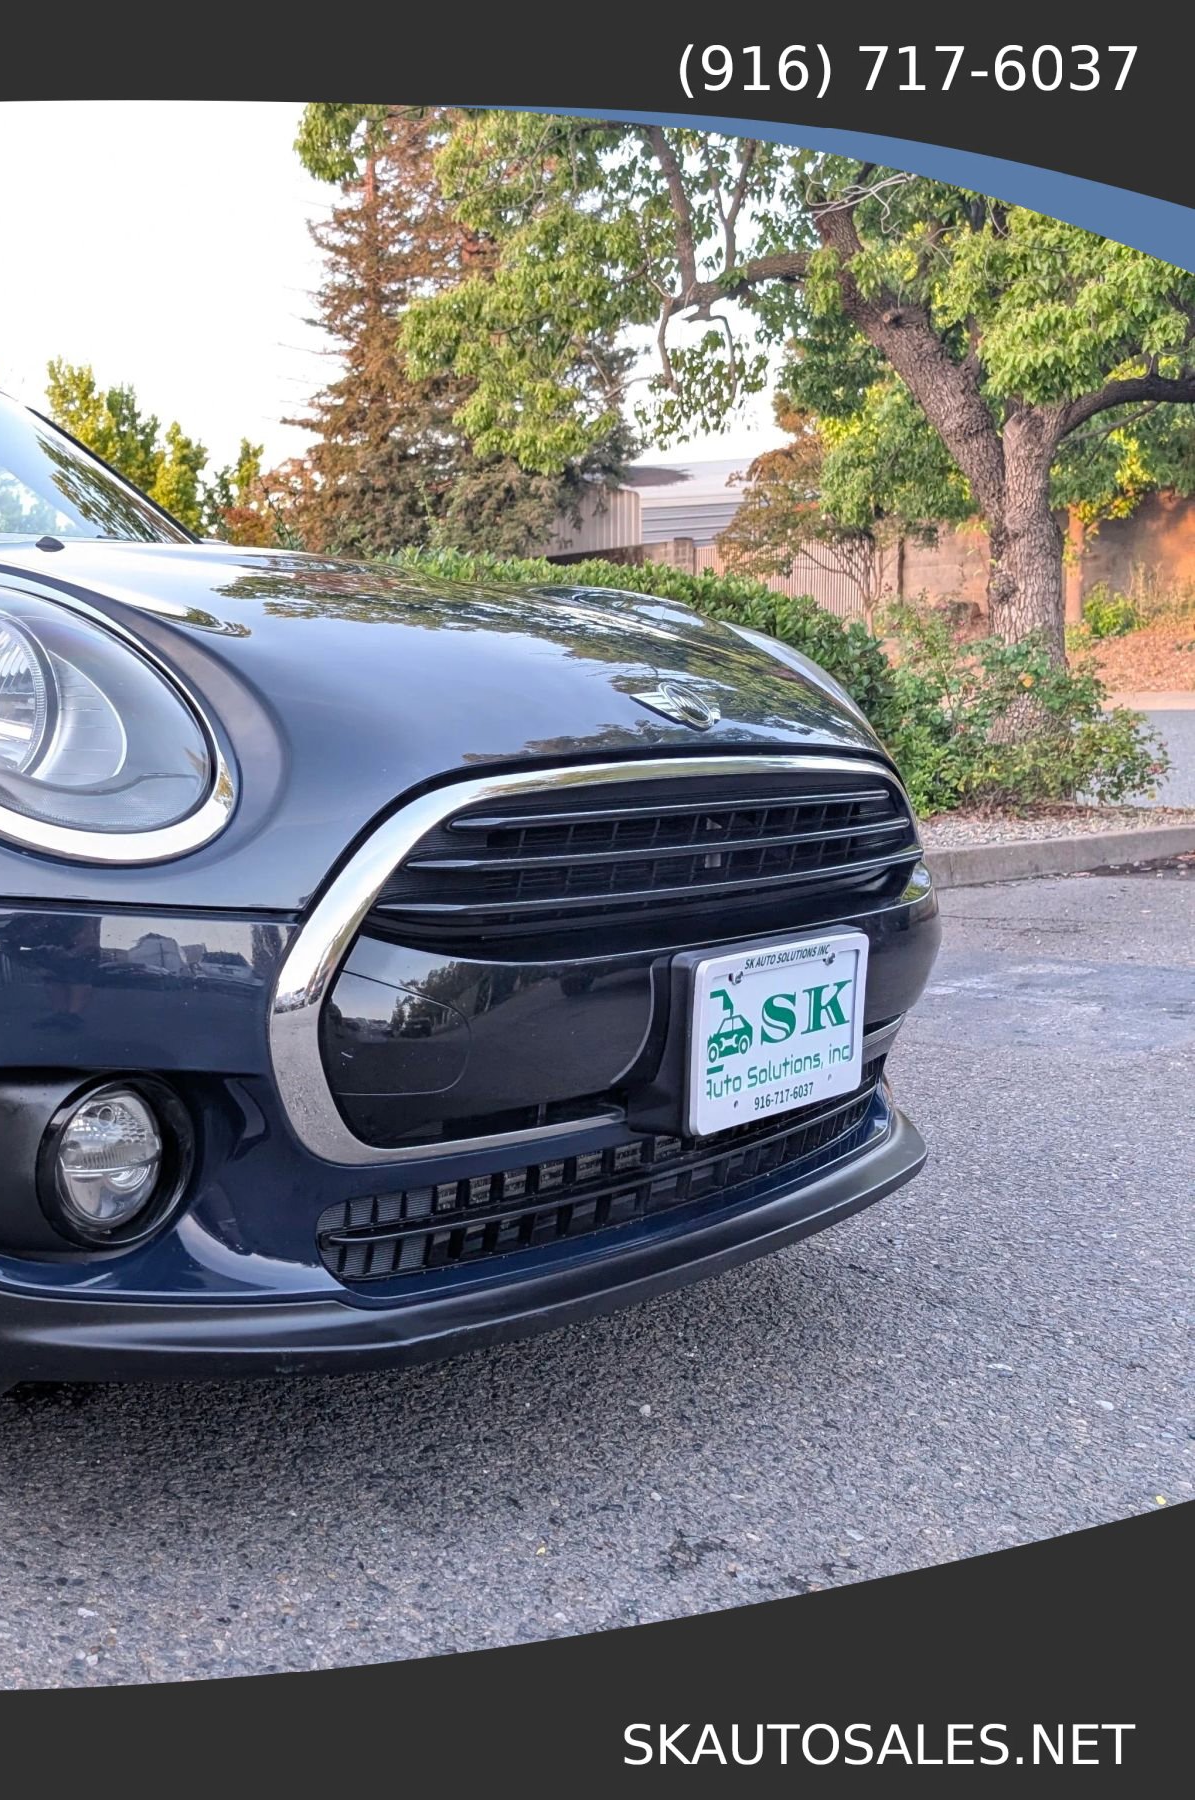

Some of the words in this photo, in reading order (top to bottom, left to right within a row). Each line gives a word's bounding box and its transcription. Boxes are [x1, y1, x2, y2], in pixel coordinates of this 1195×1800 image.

[744, 958, 756, 970] SK
[755, 954, 776, 969] AUTO
[776, 947, 818, 964] SOLUTIONS
[817, 944, 830, 957] INC
[760, 979, 852, 1046] SK
[747, 1052, 824, 1088] Solutions,
[828, 1043, 850, 1064] inc
[754, 1082, 814, 1110] 916-717-6037
